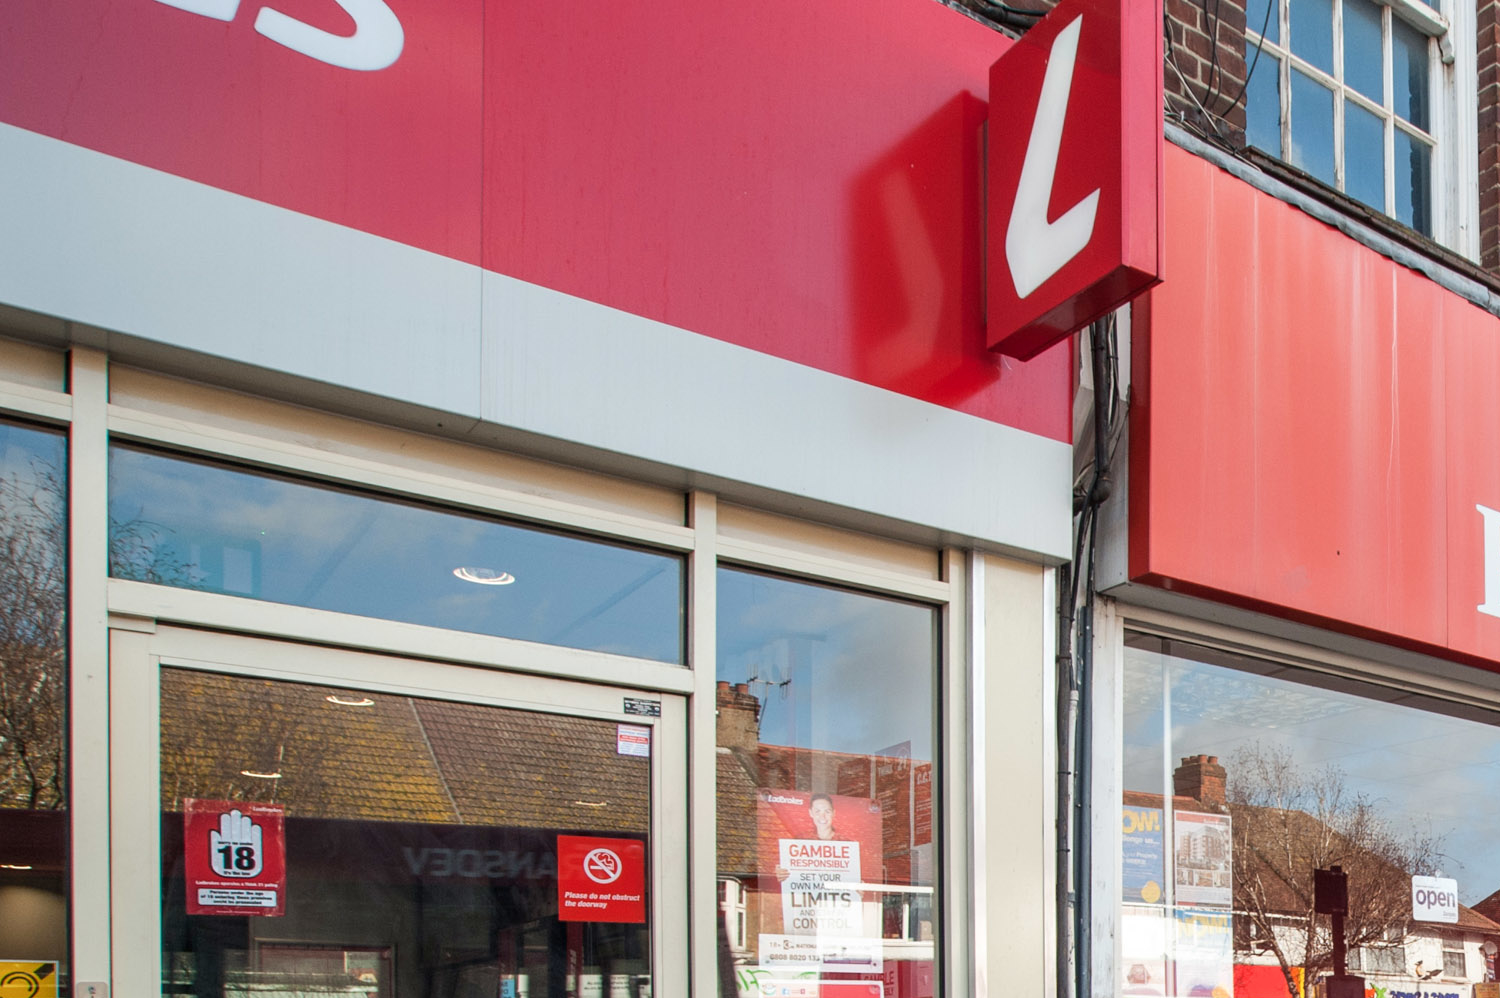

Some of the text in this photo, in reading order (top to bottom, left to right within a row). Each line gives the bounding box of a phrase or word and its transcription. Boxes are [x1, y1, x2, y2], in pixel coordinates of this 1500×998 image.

[1122, 809, 1161, 834] OW!
[217, 845, 257, 871] 18
[788, 844, 850, 859] GAMBLE
[789, 859, 850, 868] RESPONSIBLY
[799, 873, 841, 882] SET YOUR
[790, 882, 816, 890] OWN
[564, 891, 641, 902] Please do not obstruct
[791, 892, 852, 908] LIMITS
[1416, 889, 1456, 910] open
[564, 899, 608, 910] the doorway
